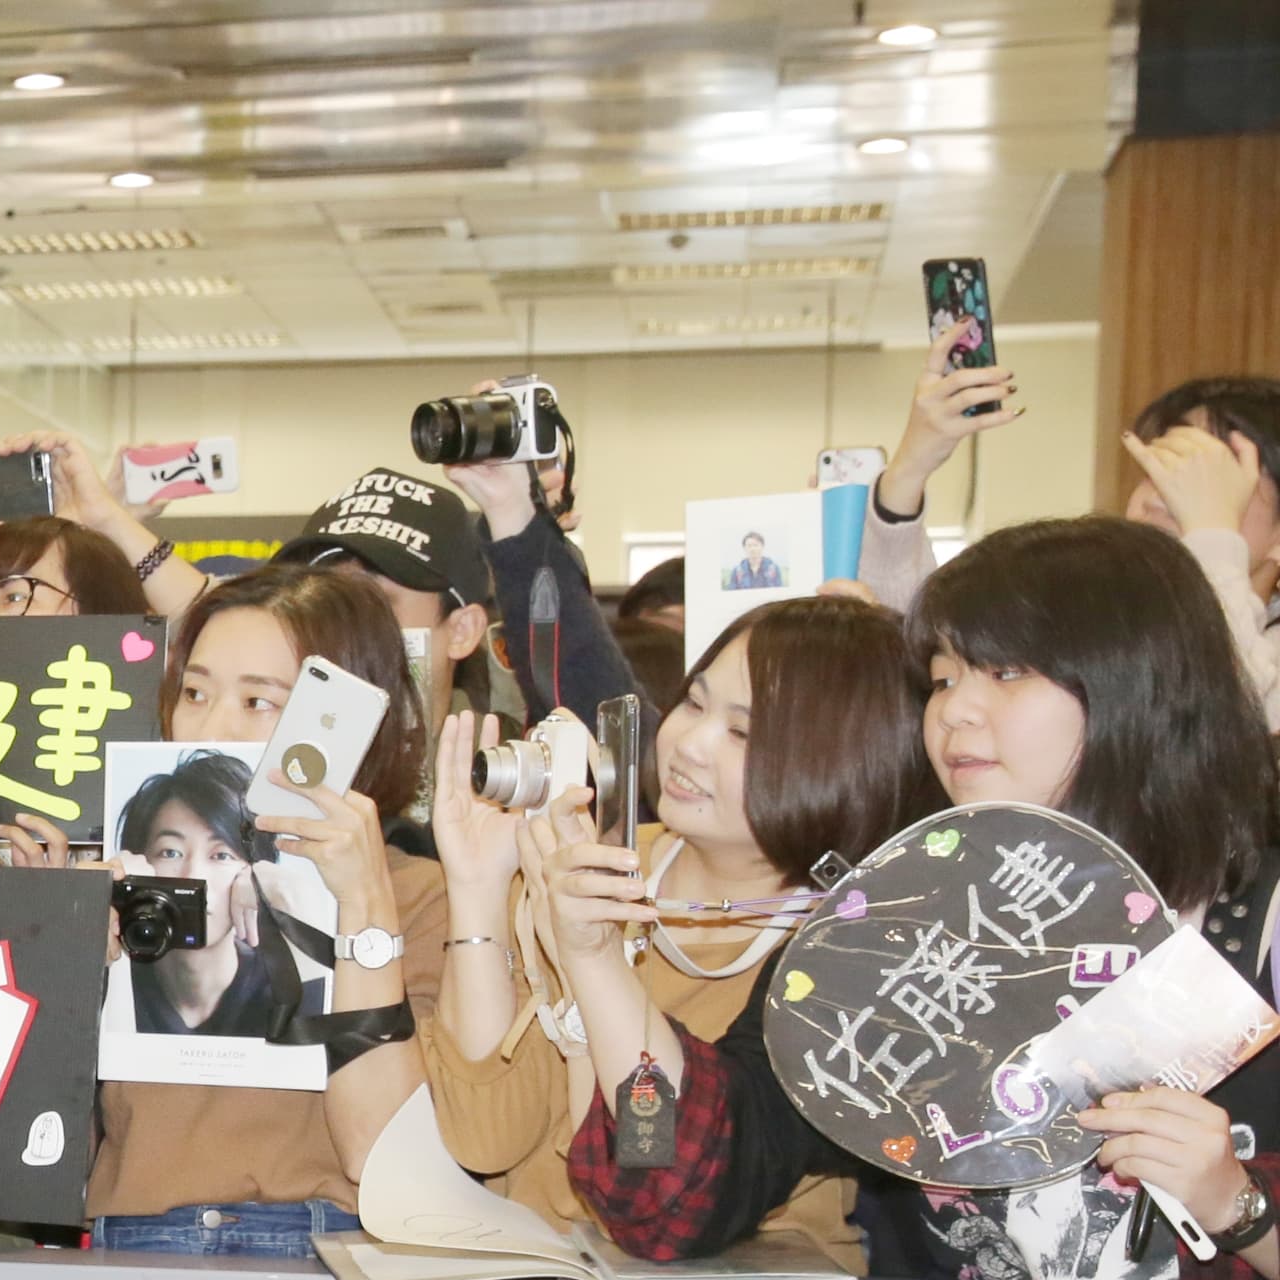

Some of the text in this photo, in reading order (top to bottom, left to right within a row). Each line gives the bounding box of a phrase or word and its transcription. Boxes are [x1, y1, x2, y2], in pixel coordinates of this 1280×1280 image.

[338, 495, 394, 517] THE
[319, 516, 431, 551] KESHIT
[802, 841, 1096, 1116] 佐藤健
